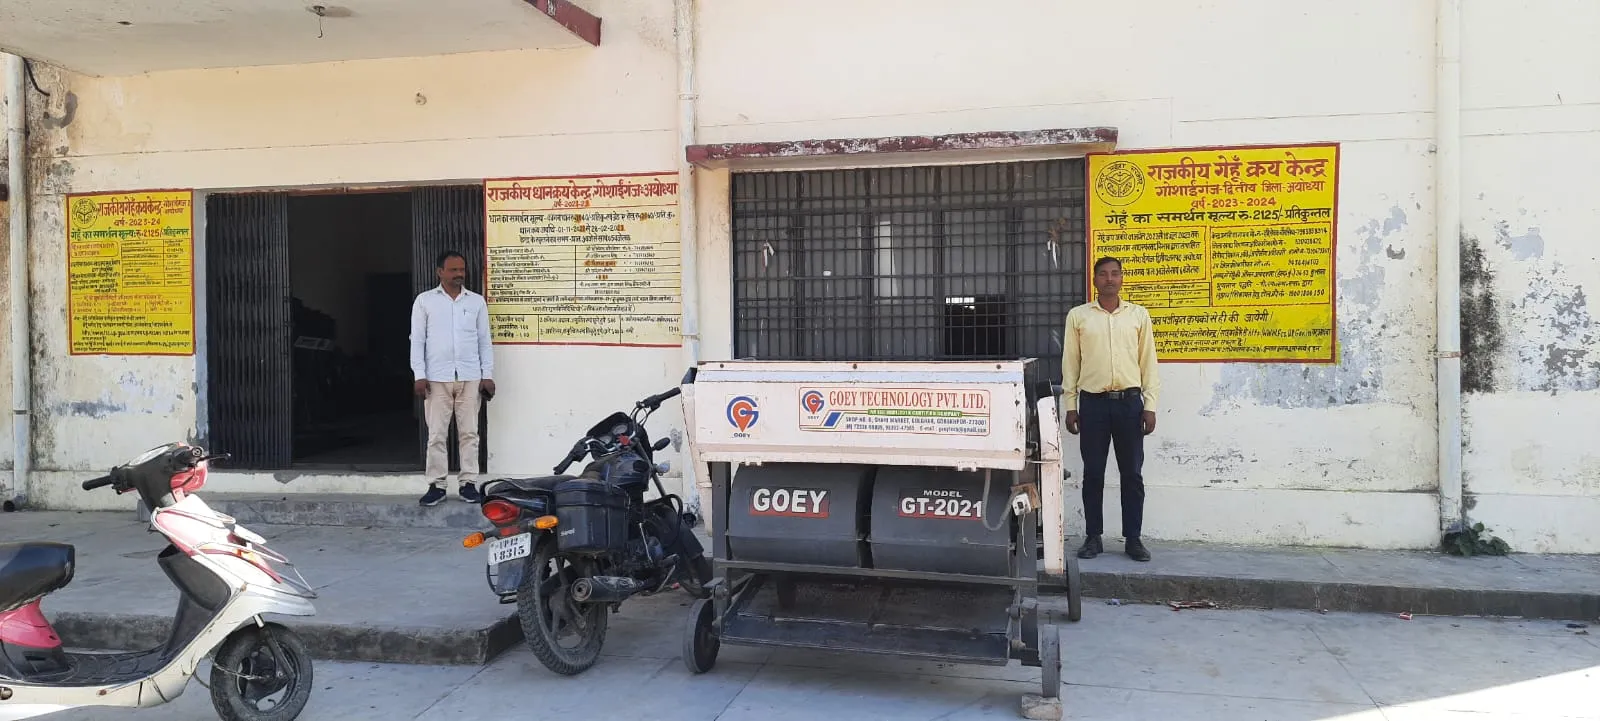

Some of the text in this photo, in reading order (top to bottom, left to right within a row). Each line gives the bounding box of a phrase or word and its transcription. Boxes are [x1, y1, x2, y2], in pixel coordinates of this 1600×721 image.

[1147, 151, 1329, 182] राजकीय गेहूँ क्रय केन्द्र
[488, 182, 532, 202] राजकीय
[1132, 213, 1153, 223] का
[1156, 208, 1205, 222] समर्थन
[829, 390, 986, 409] GOEY TECHNOLOGY PVT. LTD.
[753, 488, 828, 514] GOEY
[923, 489, 963, 497] MODEL
[901, 497, 984, 518] GT-2021
